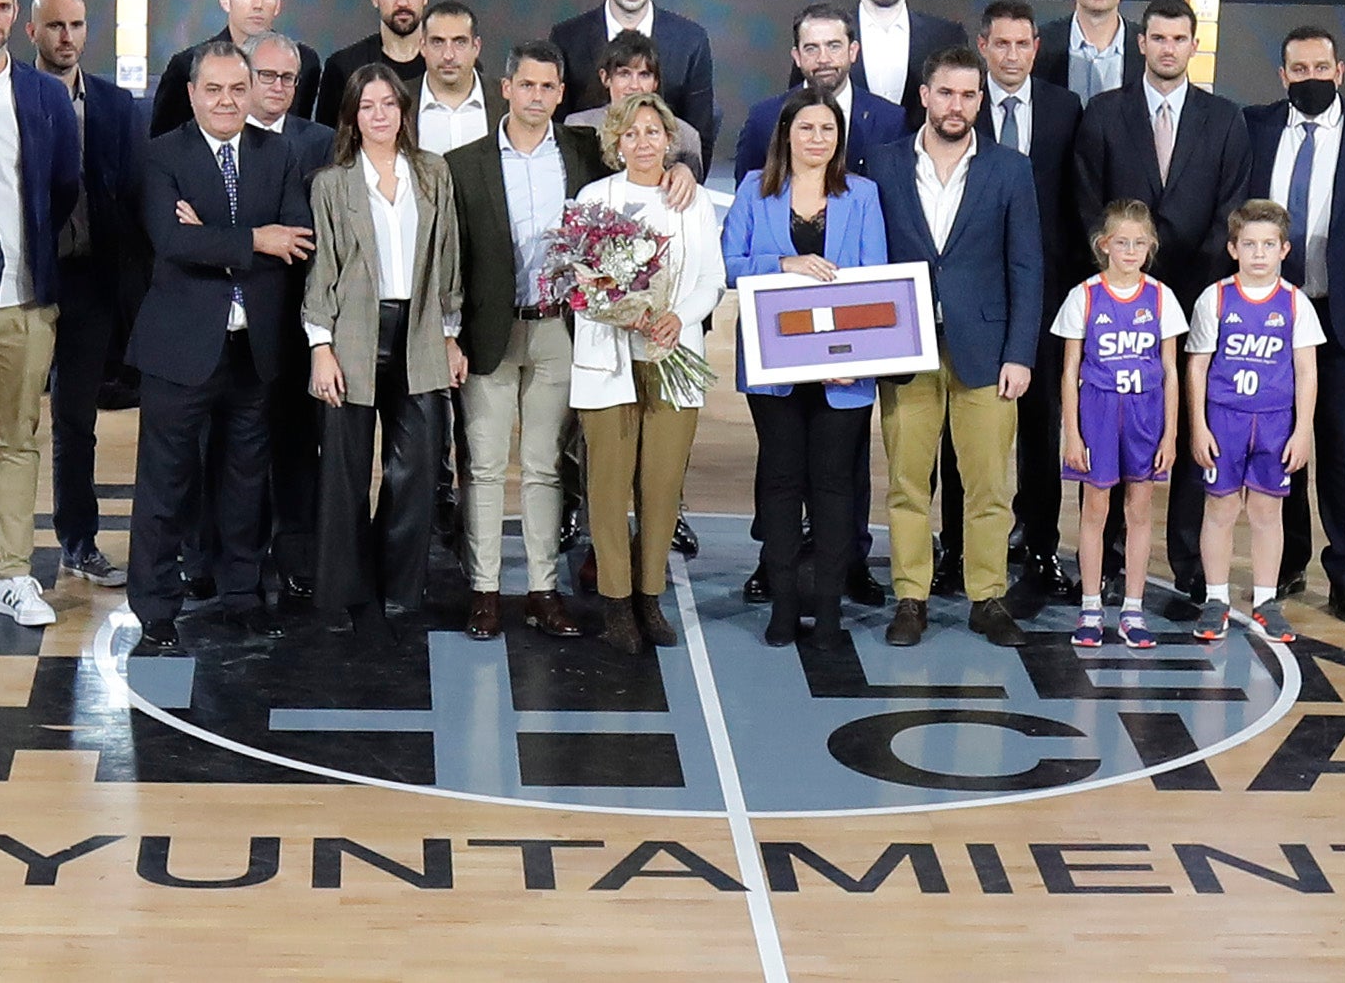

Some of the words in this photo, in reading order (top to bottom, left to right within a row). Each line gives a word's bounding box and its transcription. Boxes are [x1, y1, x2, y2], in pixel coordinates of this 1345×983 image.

[1098, 330, 1155, 357] SMP
[1224, 333, 1284, 359] SMP
[1115, 368, 1142, 394] 51
[1232, 368, 1259, 396] 10
